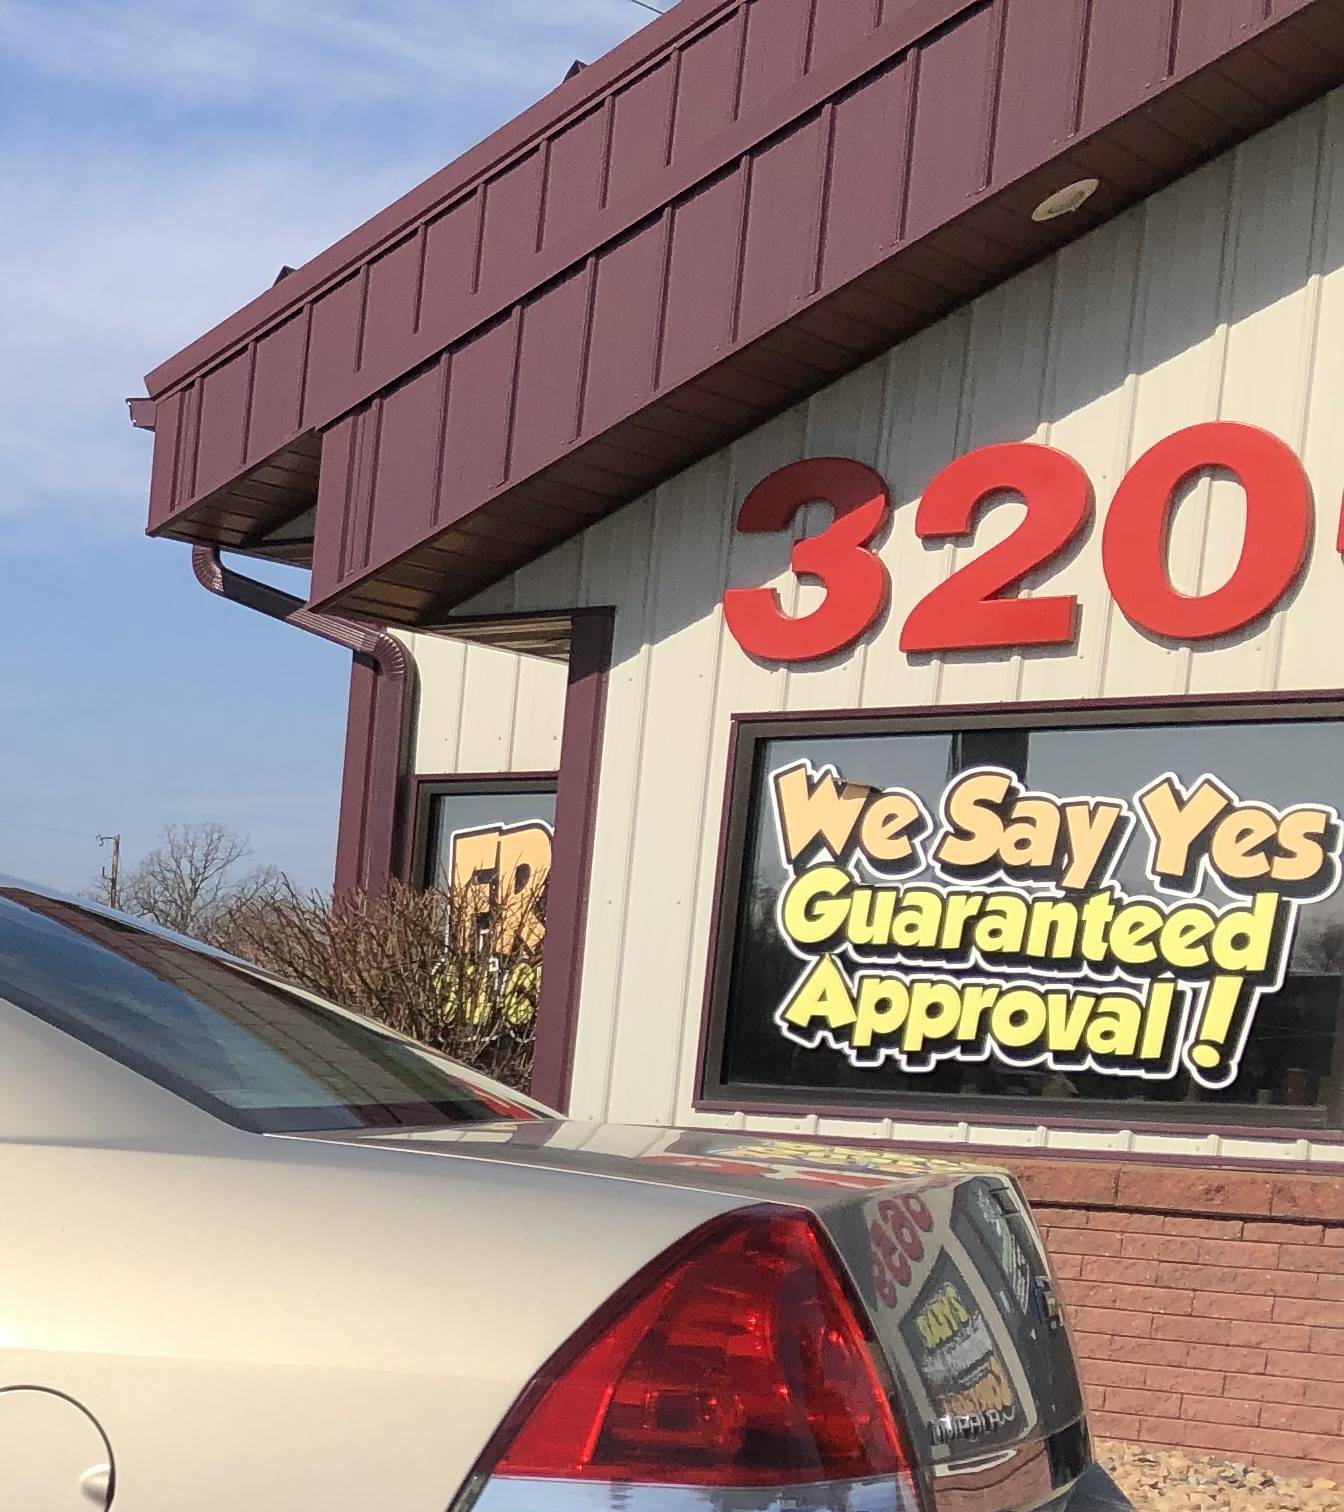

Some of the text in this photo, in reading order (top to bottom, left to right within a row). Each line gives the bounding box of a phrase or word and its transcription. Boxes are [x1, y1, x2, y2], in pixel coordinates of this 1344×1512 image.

[721, 420, 1344, 663] 320
[771, 760, 1338, 892] We Say Yes
[780, 864, 1285, 979] Guaranteed
